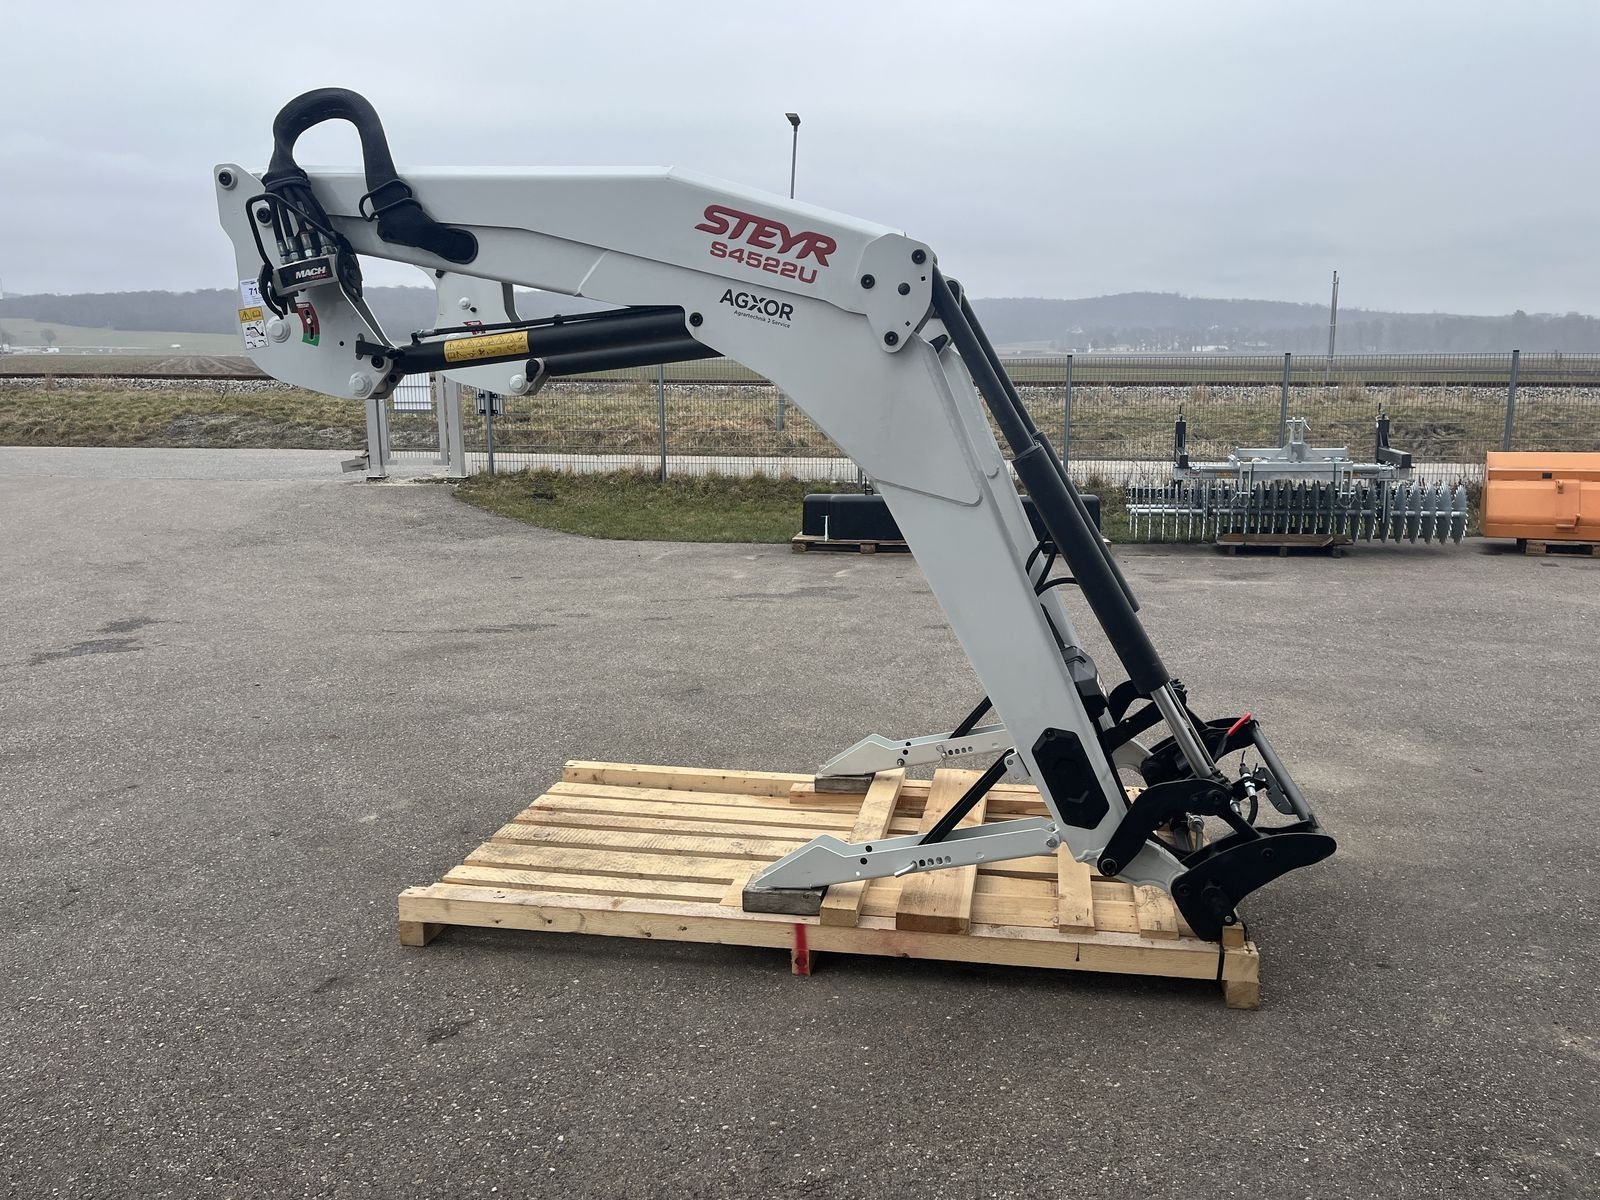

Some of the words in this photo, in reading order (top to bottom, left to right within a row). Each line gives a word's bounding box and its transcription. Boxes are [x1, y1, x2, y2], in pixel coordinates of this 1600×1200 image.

[694, 205, 837, 267] STEYR
[296, 266, 326, 279] MACH
[710, 241, 817, 284] S4522U
[720, 289, 793, 320] AGXOR
